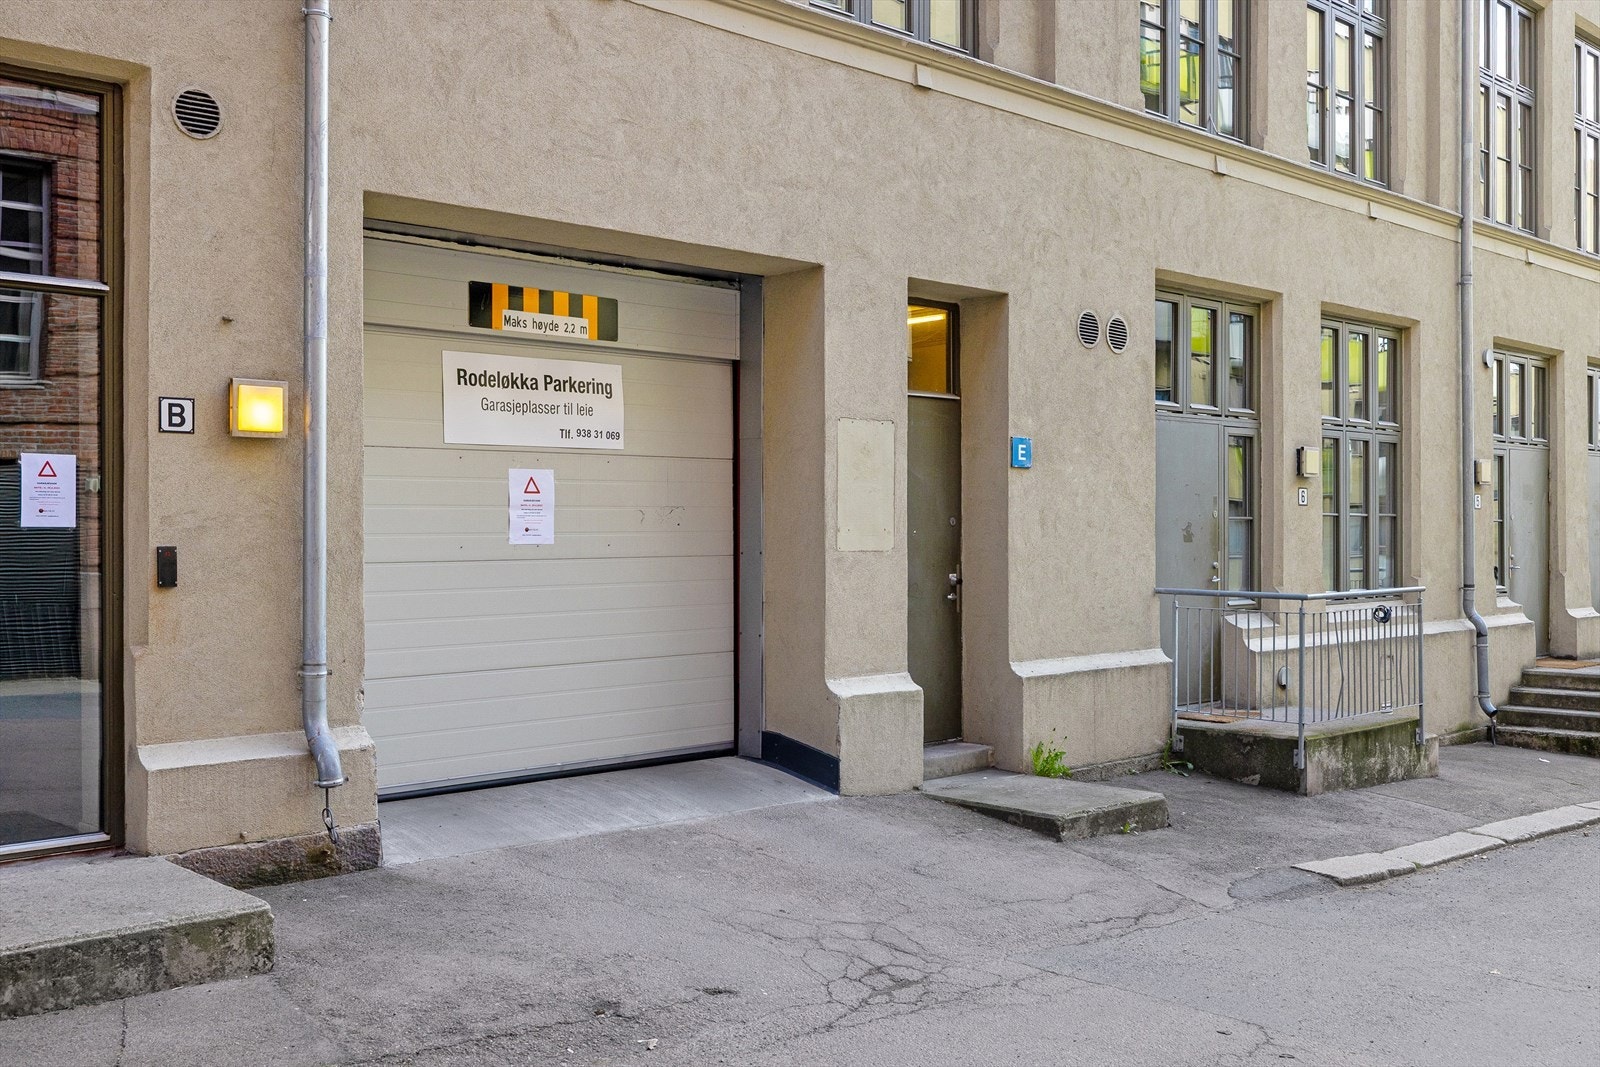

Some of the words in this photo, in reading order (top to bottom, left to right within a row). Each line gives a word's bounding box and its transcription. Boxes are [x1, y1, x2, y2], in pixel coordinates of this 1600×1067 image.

[504, 314, 527, 329] Maks
[532, 318, 559, 334] høyde
[579, 325, 588, 335] m
[456, 368, 539, 391] Rodeløkka
[543, 374, 613, 399] Parkering
[168, 402, 186, 428] B
[480, 397, 561, 416] Garasjeplasser
[563, 402, 573, 416] til
[576, 403, 594, 417] leie
[559, 428, 574, 440] Tlf.
[576, 428, 592, 439] 938
[593, 429, 603, 440] 31
[605, 430, 621, 441] 069
[1018, 444, 1027, 461] E
[1301, 490, 1306, 503] 6
